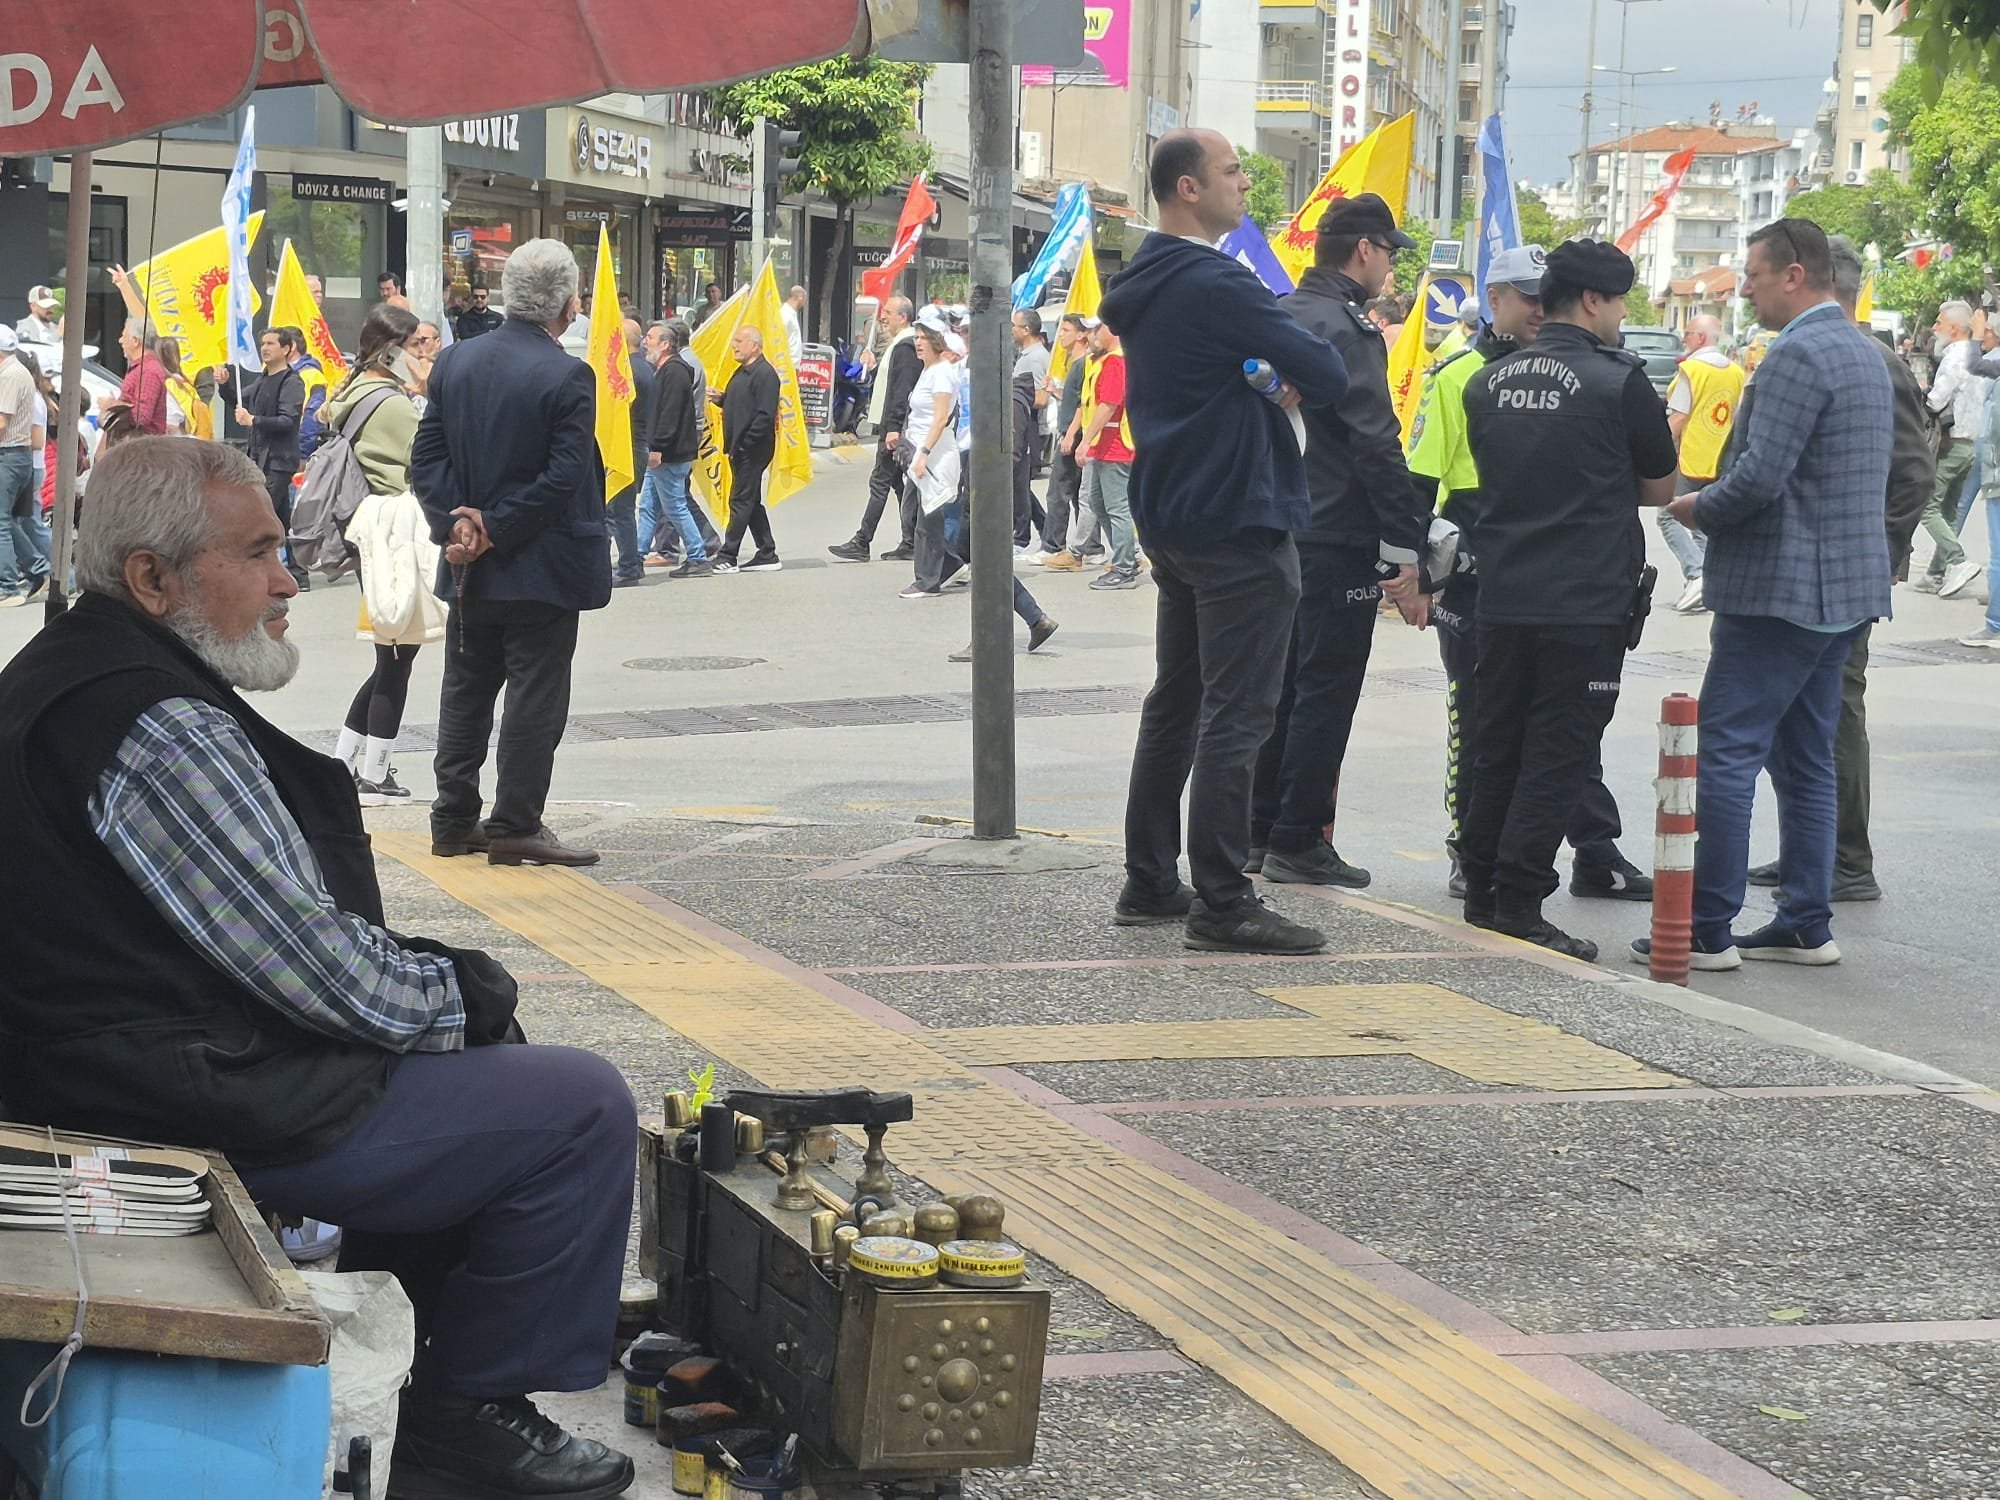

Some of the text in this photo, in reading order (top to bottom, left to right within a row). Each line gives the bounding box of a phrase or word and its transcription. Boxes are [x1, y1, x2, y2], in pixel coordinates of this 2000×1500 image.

[593, 126, 651, 180] SEZAR
[331, 183, 341, 198] &
[343, 183, 387, 200] CHANGE
[566, 209, 610, 222] SEZAR
[1531, 356, 1582, 396] KUVVET
